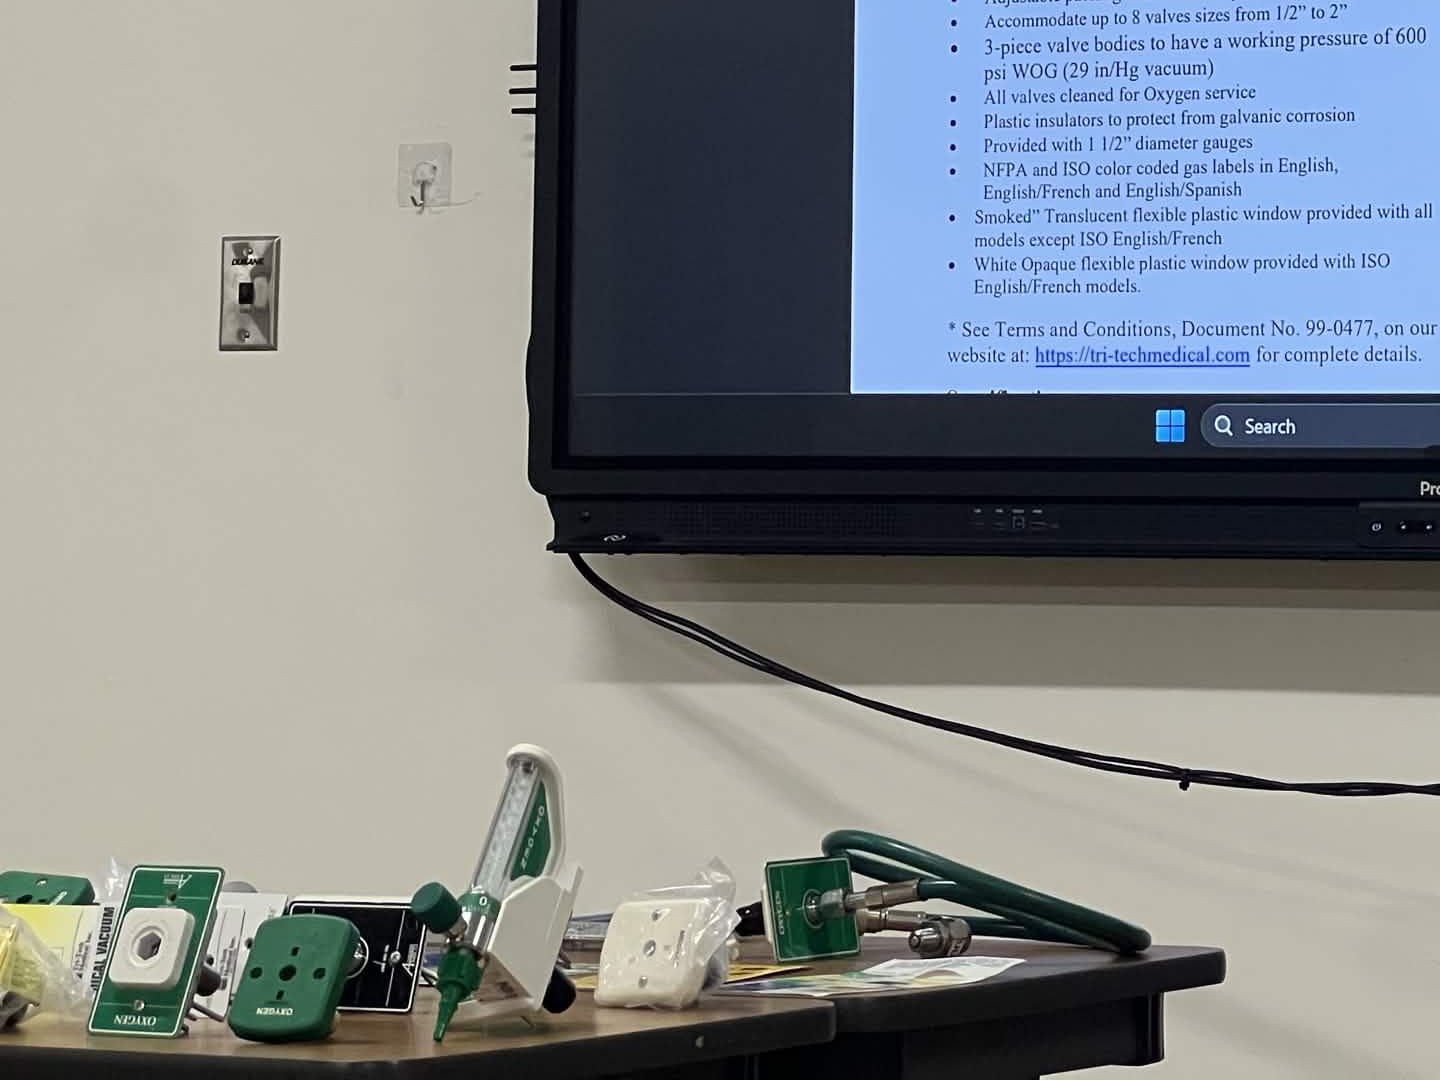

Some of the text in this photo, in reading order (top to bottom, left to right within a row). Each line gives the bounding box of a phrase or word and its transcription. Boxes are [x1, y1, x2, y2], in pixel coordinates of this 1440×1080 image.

[961, 322, 990, 338] See
[994, 321, 1045, 338] Terms
[1049, 321, 1077, 338] and
[1083, 321, 1176, 340] Conditions,
[1181, 320, 1265, 337] Document
[1271, 320, 1300, 337] No.
[1305, 320, 1378, 339] 99-0477,
[1383, 325, 1404, 336] on
[1409, 325, 1438, 336] our
[946, 345, 1421, 368] website at: https://tri-techmedical.com for complete details.
[1244, 418, 1295, 435] Search
[256, 1006, 294, 1016] OXYGEN
[113, 1013, 157, 1027] OXYGEN
